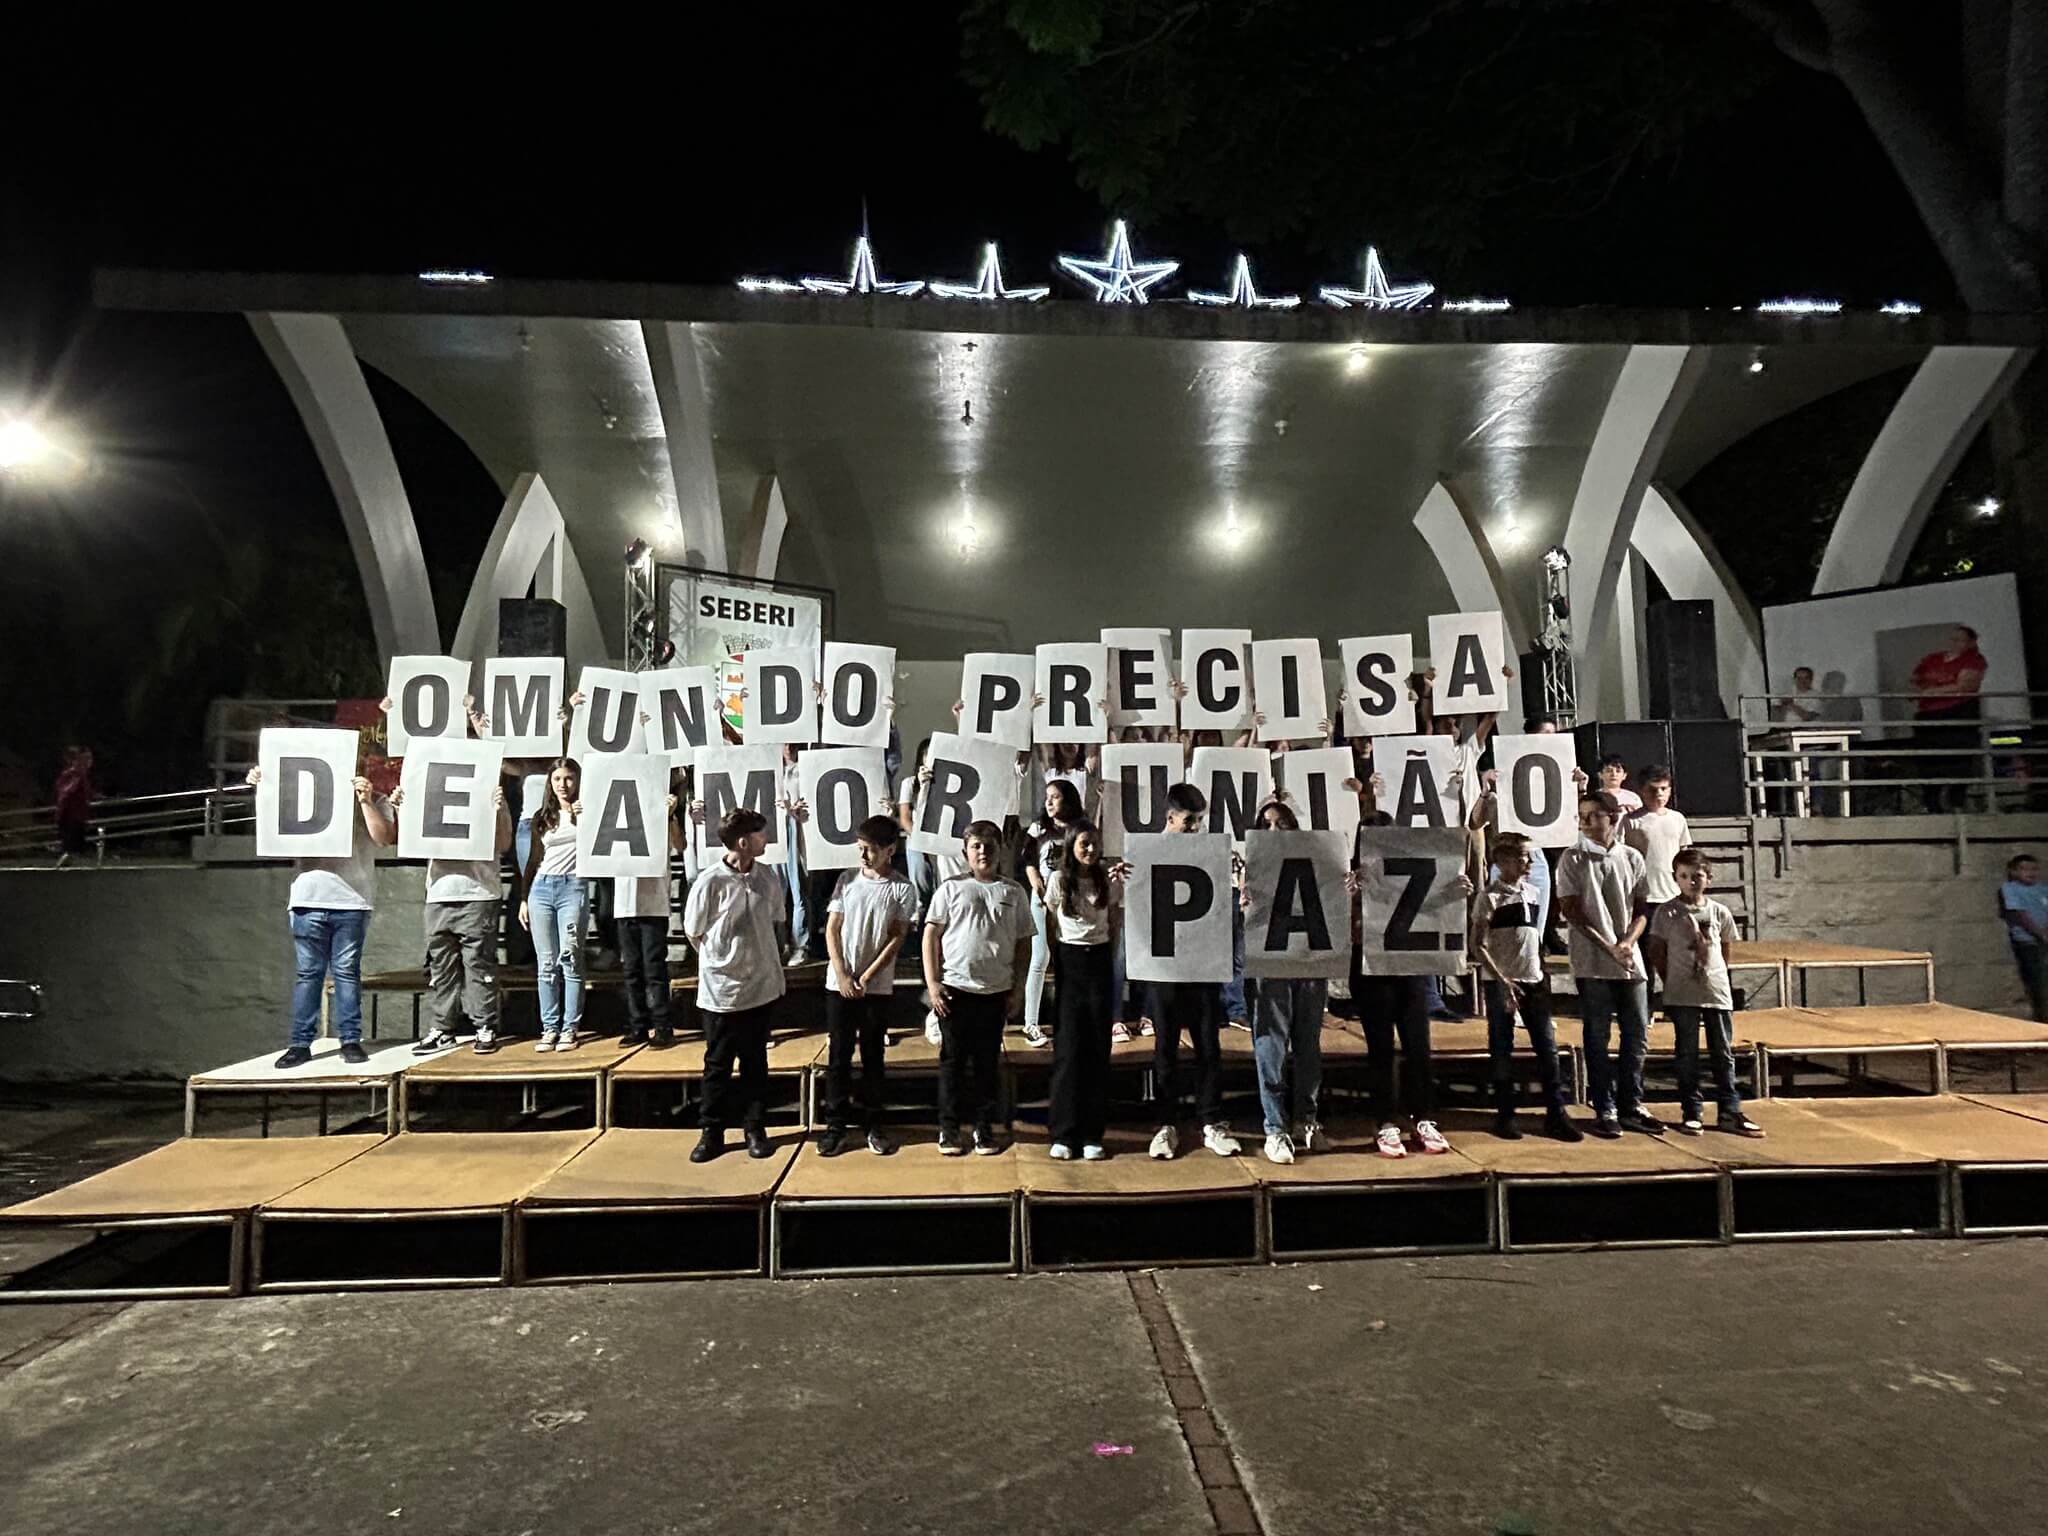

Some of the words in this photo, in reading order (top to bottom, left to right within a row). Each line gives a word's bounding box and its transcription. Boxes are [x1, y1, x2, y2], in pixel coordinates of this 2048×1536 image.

[700, 595, 795, 627] SEBERI
[976, 634, 1495, 734] PRECISA
[278, 756, 475, 839] DE
[591, 758, 981, 857] AMOR
